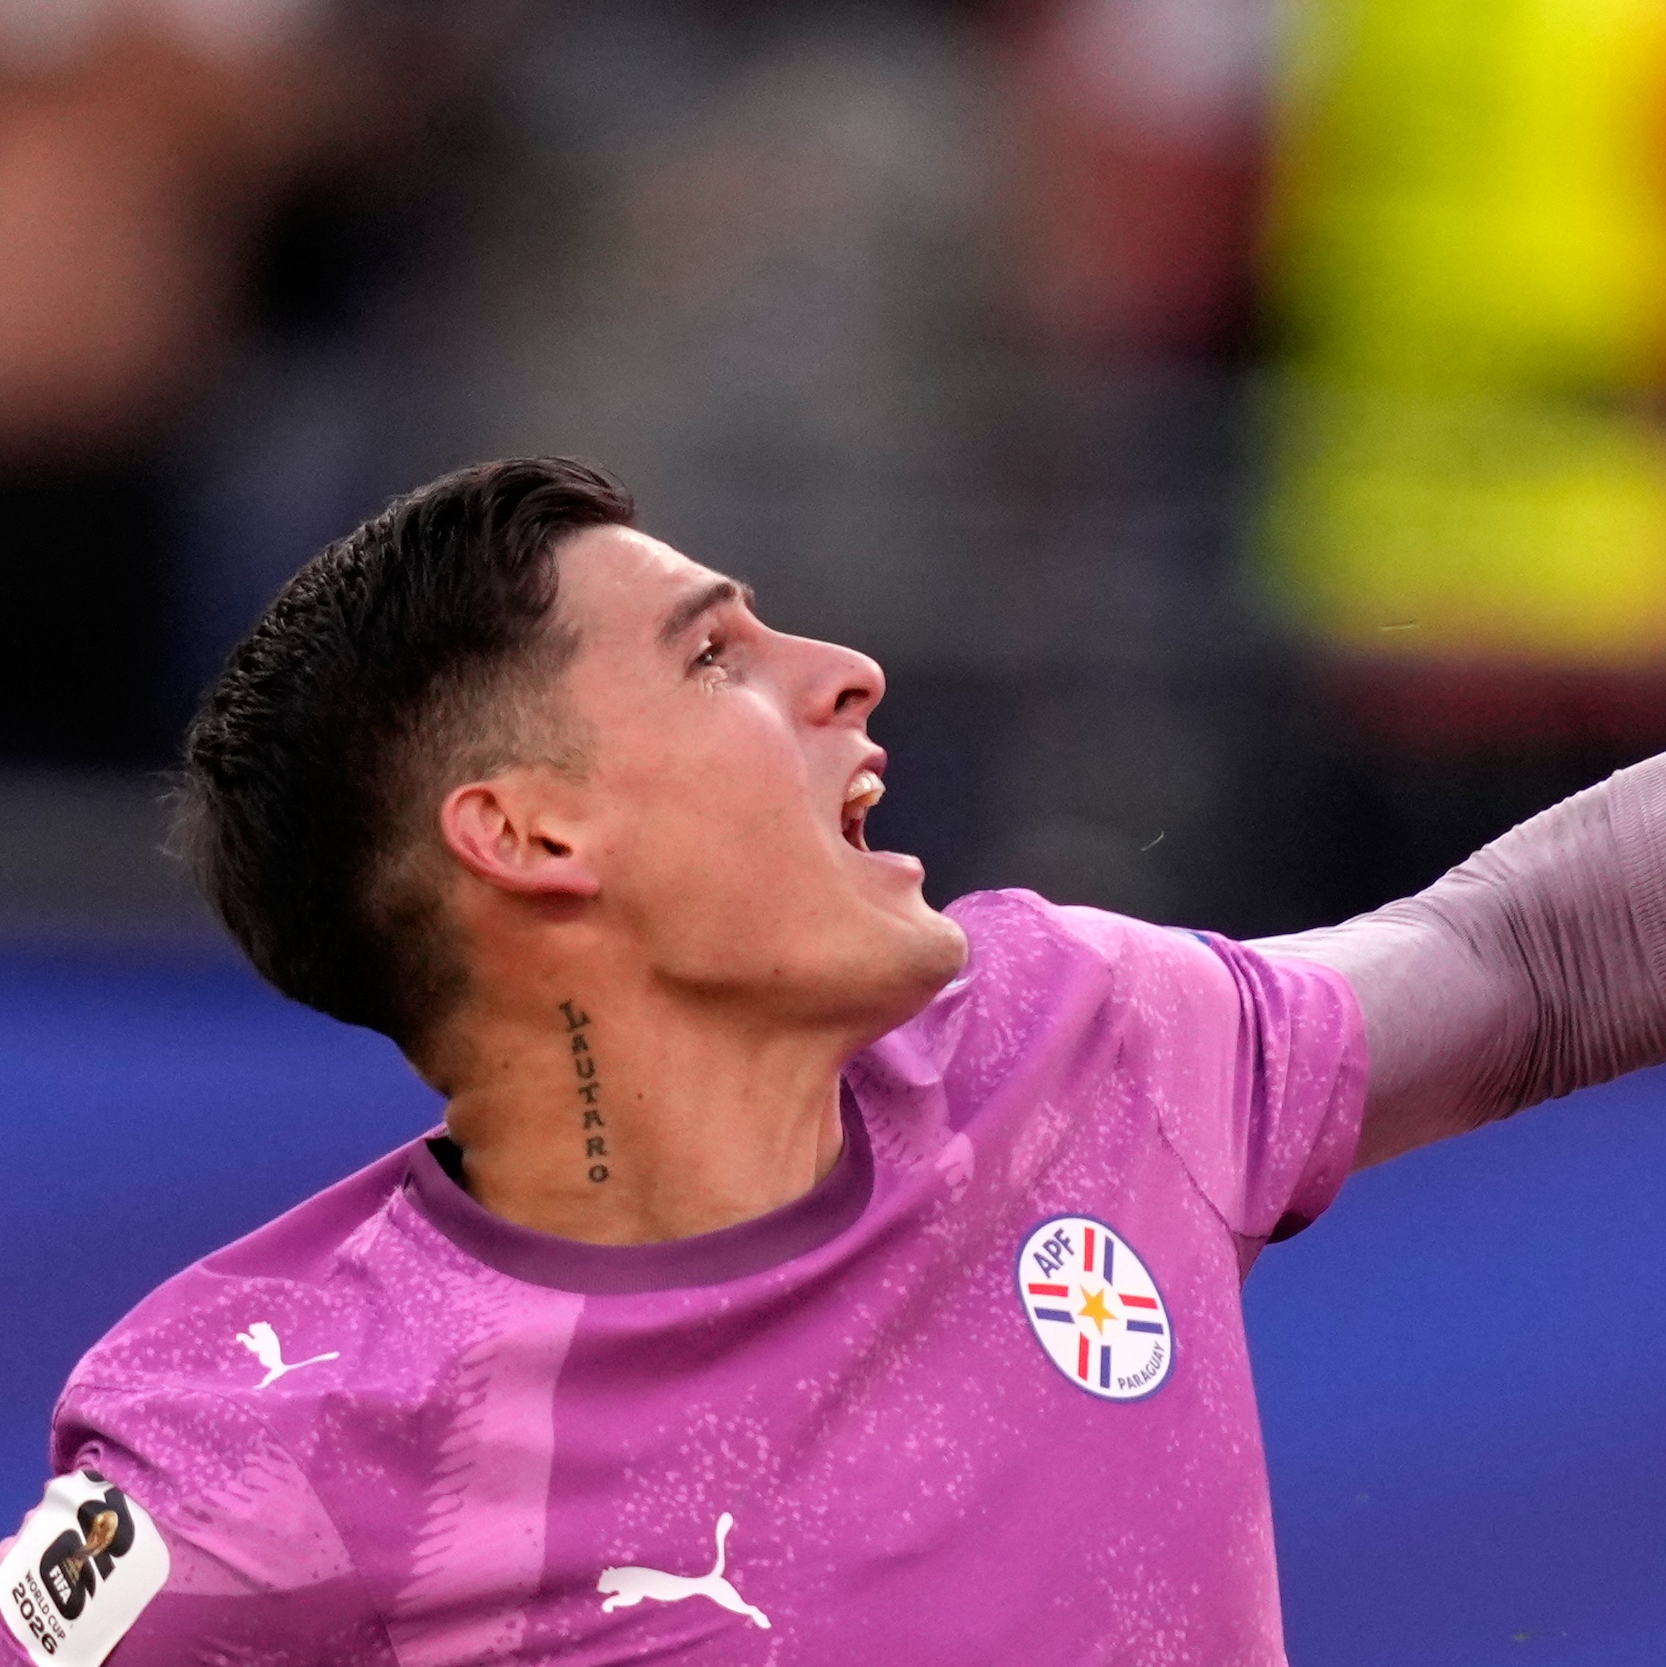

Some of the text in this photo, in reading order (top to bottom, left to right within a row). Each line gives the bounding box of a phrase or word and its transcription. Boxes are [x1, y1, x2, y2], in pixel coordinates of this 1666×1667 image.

[1033, 1227, 1075, 1279] APF
[1117, 1341, 1165, 1390] PARAGUAY
[24, 1569, 67, 1640] WORLD CUP
[49, 1564, 72, 1605] FIFA
[11, 1582, 58, 1656] 2026
